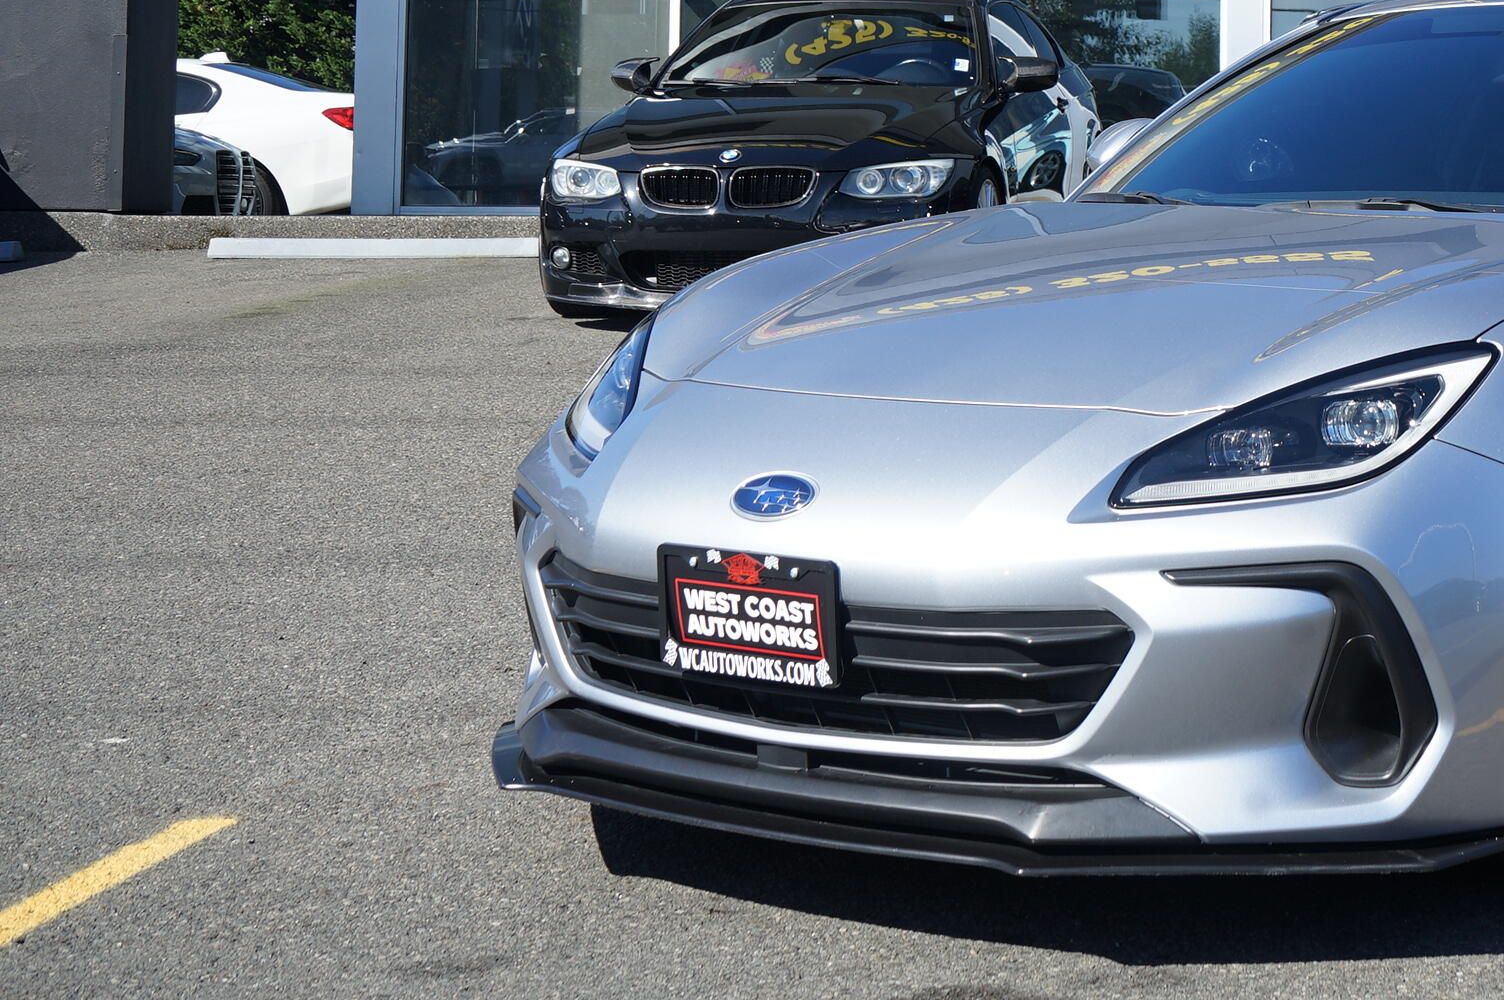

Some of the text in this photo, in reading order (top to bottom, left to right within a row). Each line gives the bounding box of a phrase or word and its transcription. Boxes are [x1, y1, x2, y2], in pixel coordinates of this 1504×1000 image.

[683, 587, 815, 625] WEST COAST
[687, 613, 819, 651] AUTOWORKS
[678, 646, 816, 687] WCAUTOWORKS.COM
